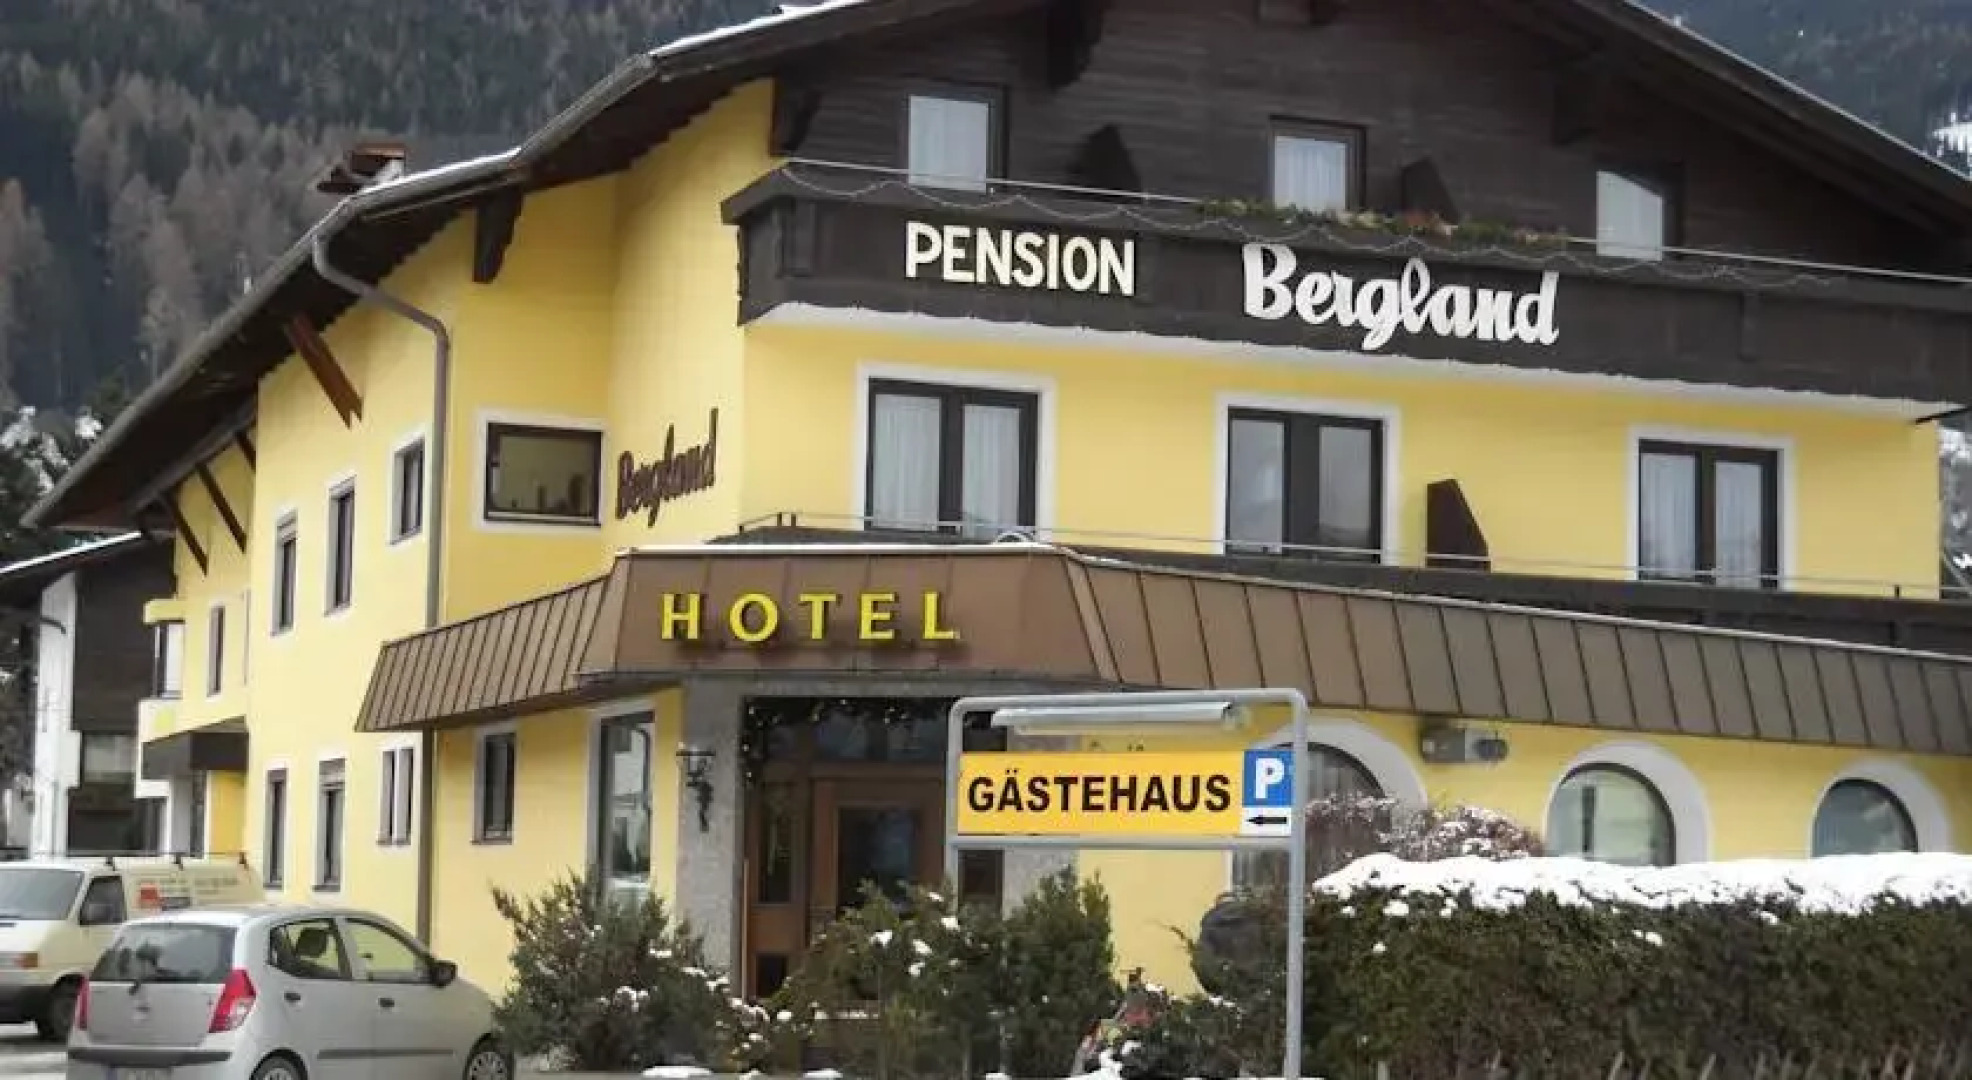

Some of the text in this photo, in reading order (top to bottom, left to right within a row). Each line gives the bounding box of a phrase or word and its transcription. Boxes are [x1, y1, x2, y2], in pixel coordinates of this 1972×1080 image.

[905, 222, 1560, 349] PENSION Bergland
[615, 407, 719, 528] Bergland
[660, 592, 958, 641] HOTEL
[967, 768, 1231, 813] GÄSTEHAUS
[1255, 757, 1286, 799] P
